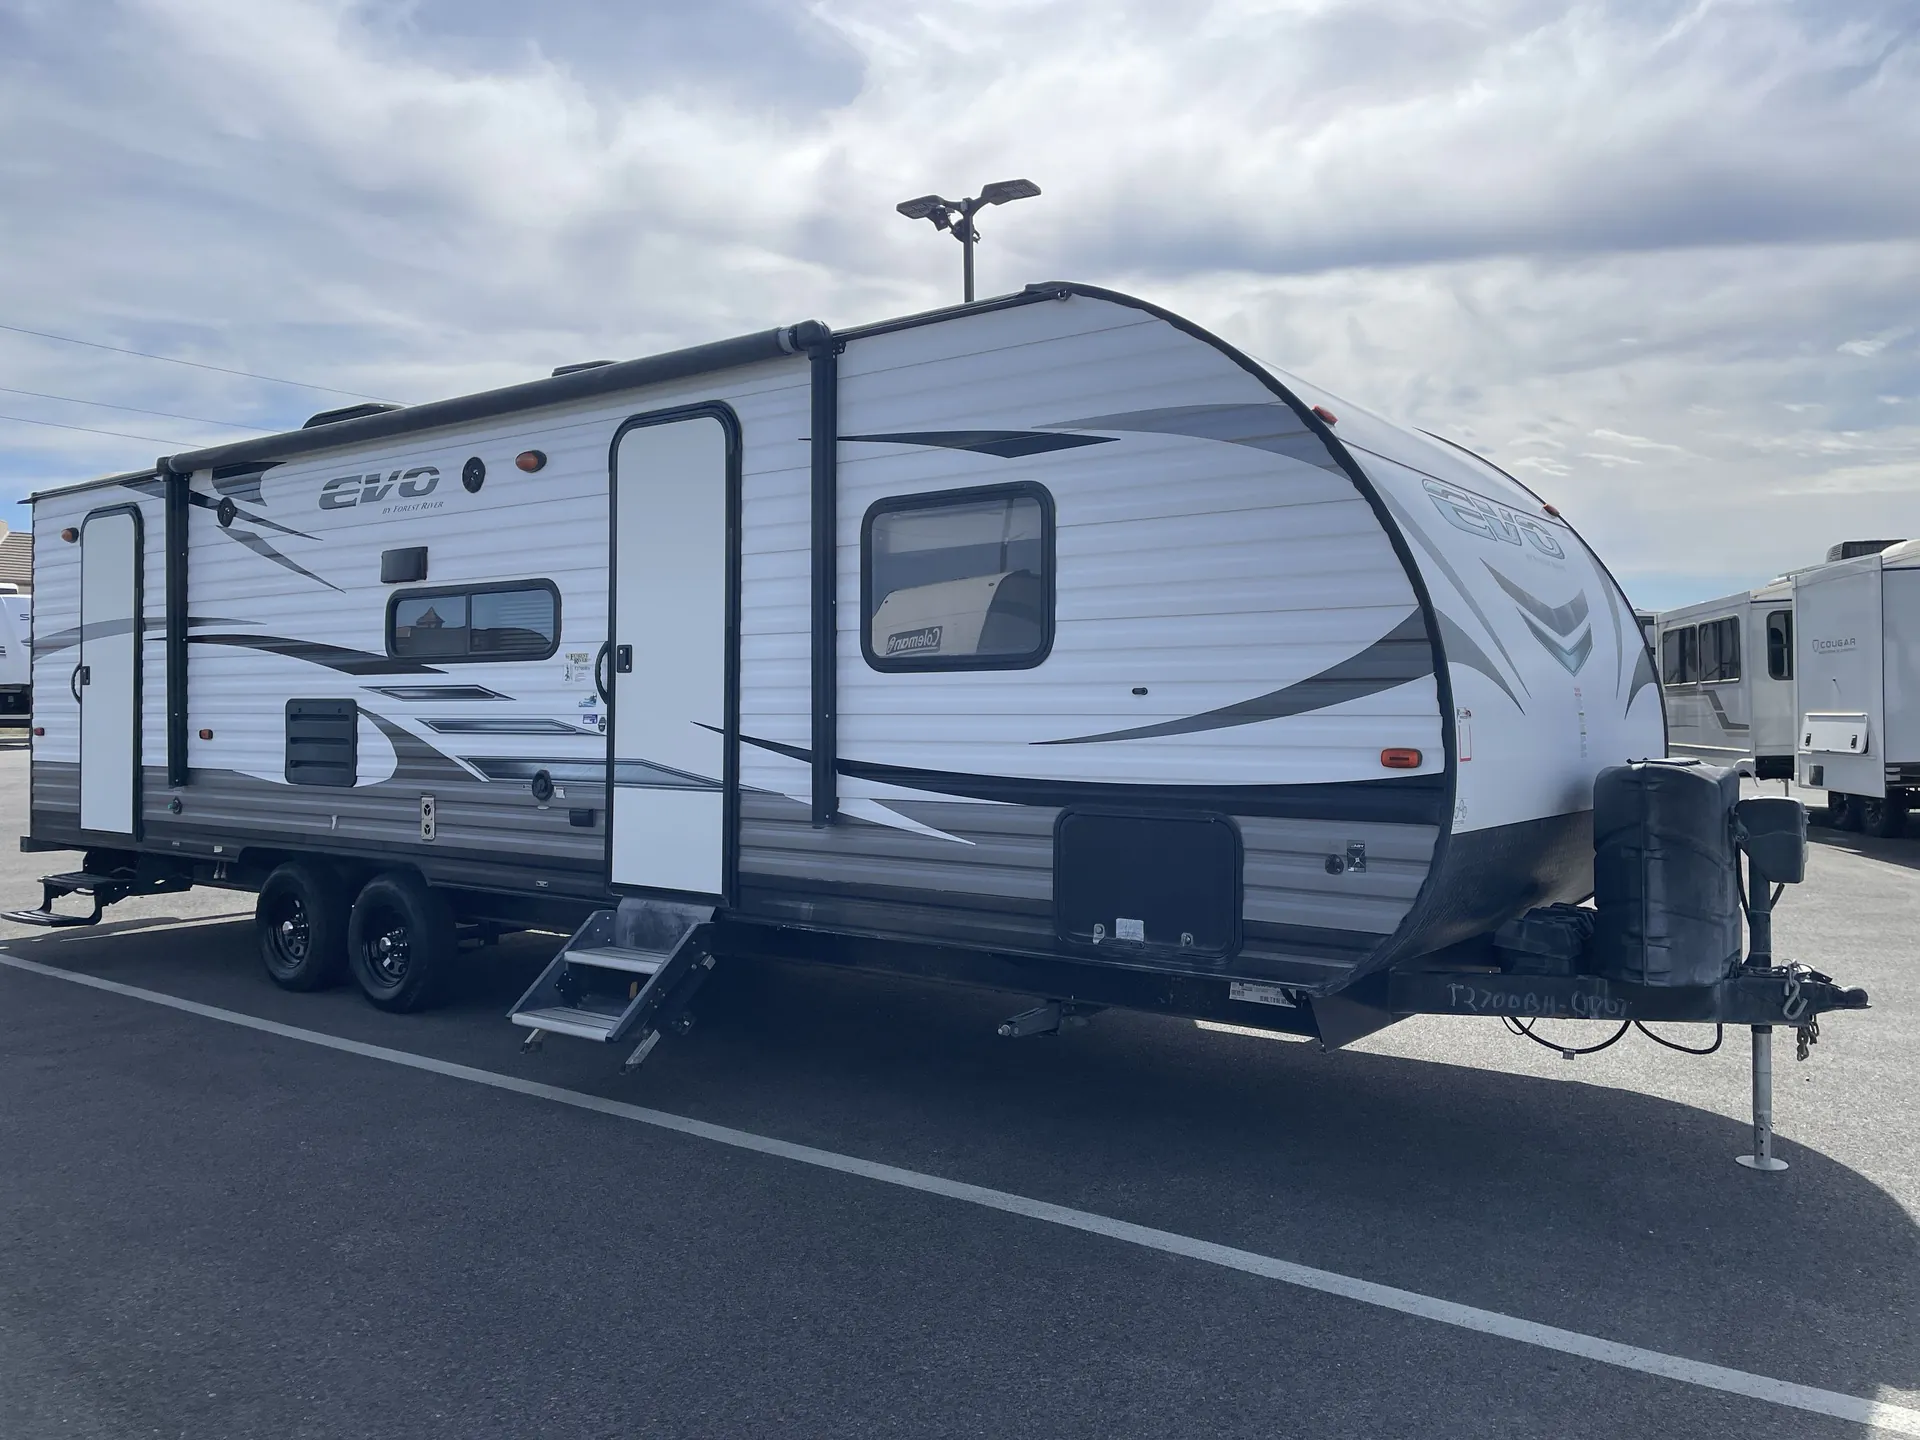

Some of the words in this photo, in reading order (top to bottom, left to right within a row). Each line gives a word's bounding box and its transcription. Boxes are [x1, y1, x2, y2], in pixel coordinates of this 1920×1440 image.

[319, 466, 440, 510] EVO
[393, 503, 420, 513] FOREST
[421, 501, 444, 510] RIVER
[1422, 478, 1565, 560] EVO
[1820, 638, 1856, 648] COUGAR
